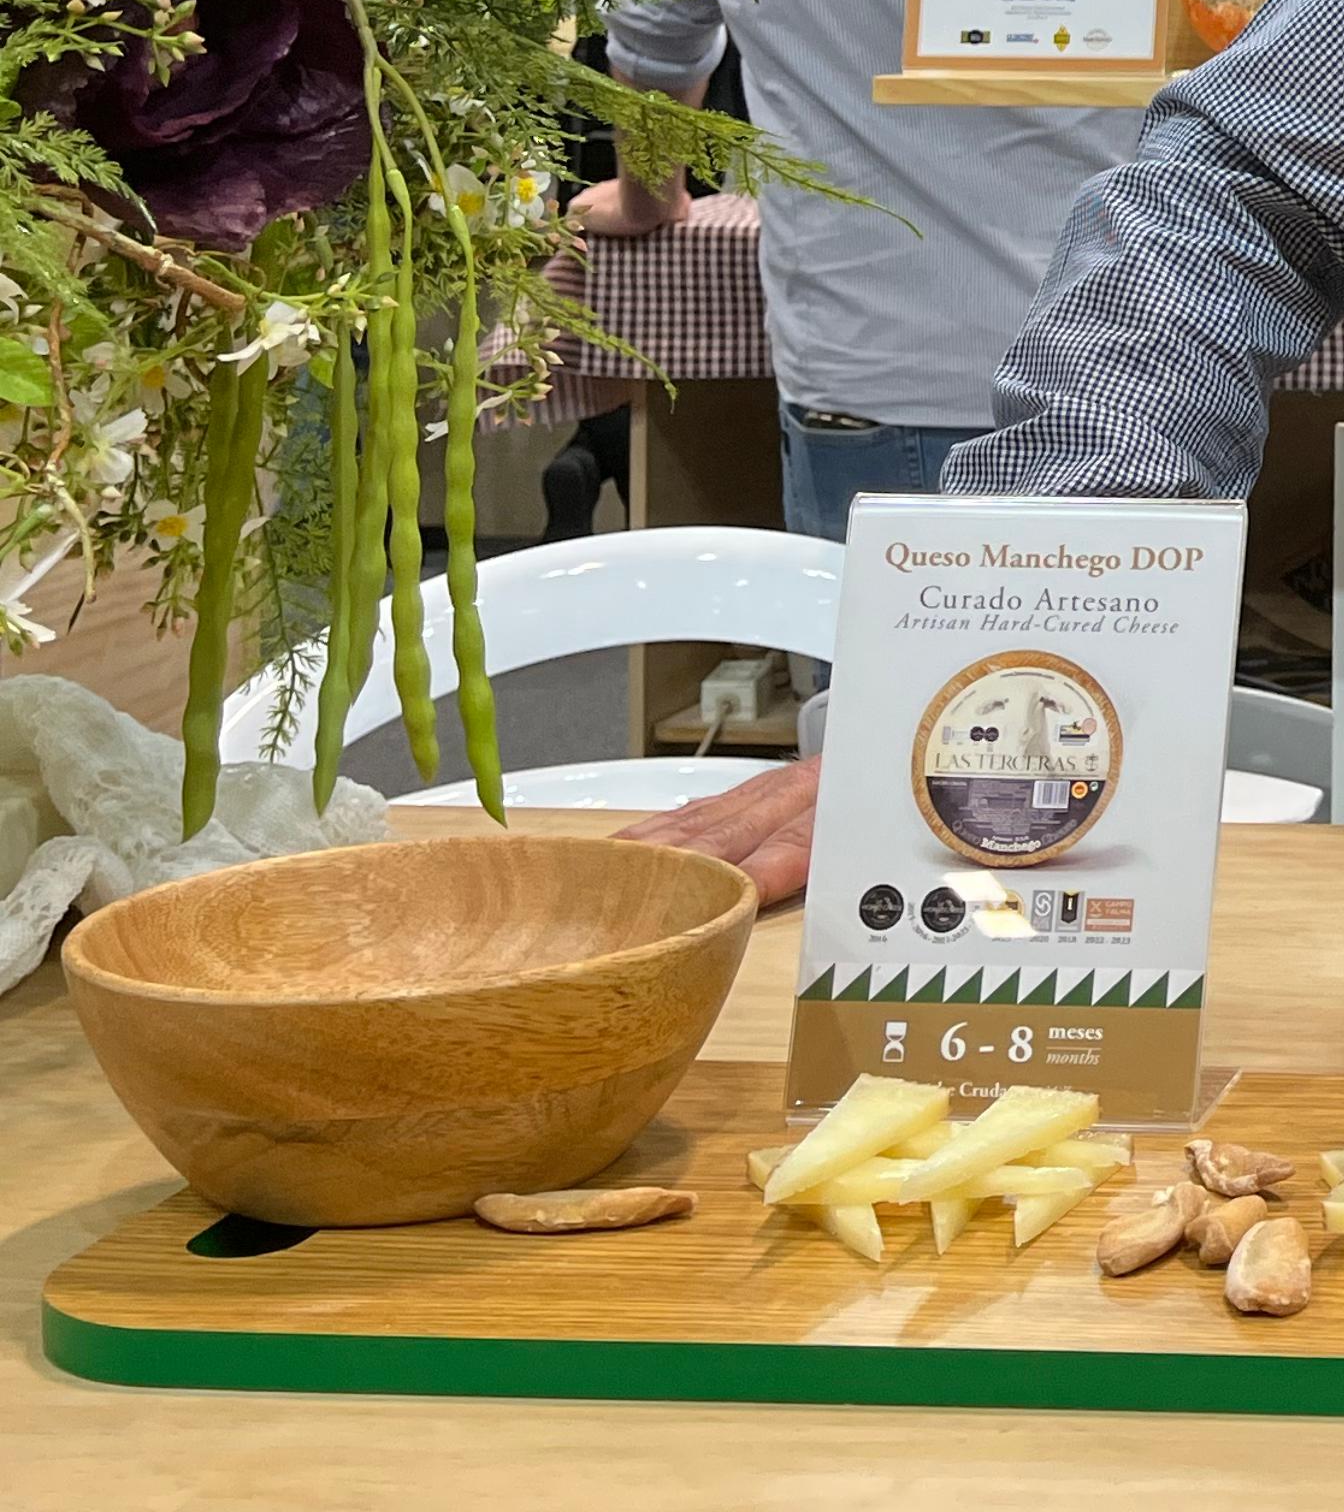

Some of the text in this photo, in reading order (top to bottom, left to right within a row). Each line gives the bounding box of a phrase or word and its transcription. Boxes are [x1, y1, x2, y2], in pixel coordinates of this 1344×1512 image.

[885, 542, 1204, 577] Queso Manchego DOP
[919, 585, 1160, 613] Curado Artesano
[894, 612, 1180, 635] Artisan Hard-Cured Cheese
[974, 753, 1077, 773] TERCERAS
[940, 1021, 969, 1062] 6
[1008, 1025, 1034, 1063] 8
[1048, 1027, 1104, 1041] meses
[1045, 1049, 1100, 1066] months
